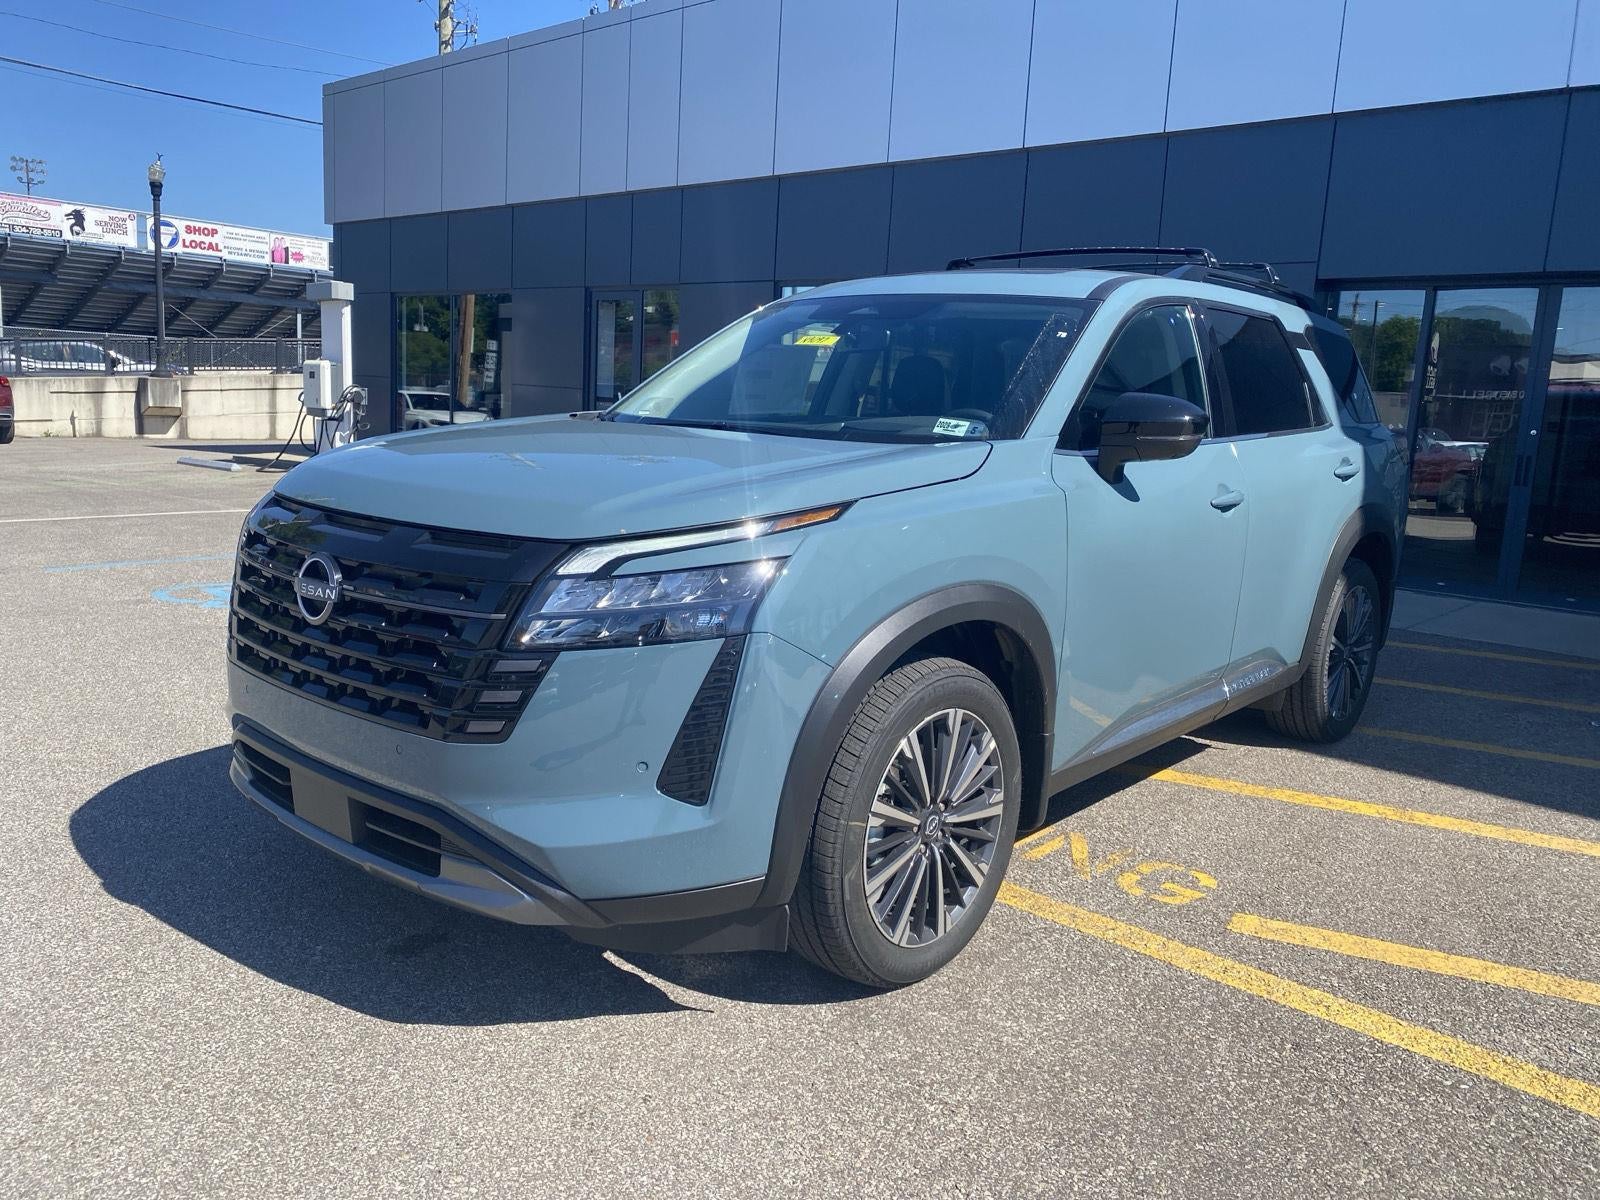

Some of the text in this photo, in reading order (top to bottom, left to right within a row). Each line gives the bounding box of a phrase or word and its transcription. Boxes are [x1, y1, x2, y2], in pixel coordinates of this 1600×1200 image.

[94, 220, 128, 229] SERVING
[102, 227, 128, 236] LUNCH
[185, 225, 218, 237] SHOP
[182, 239, 222, 252] LOCAL
[301, 583, 336, 599] SSAN
